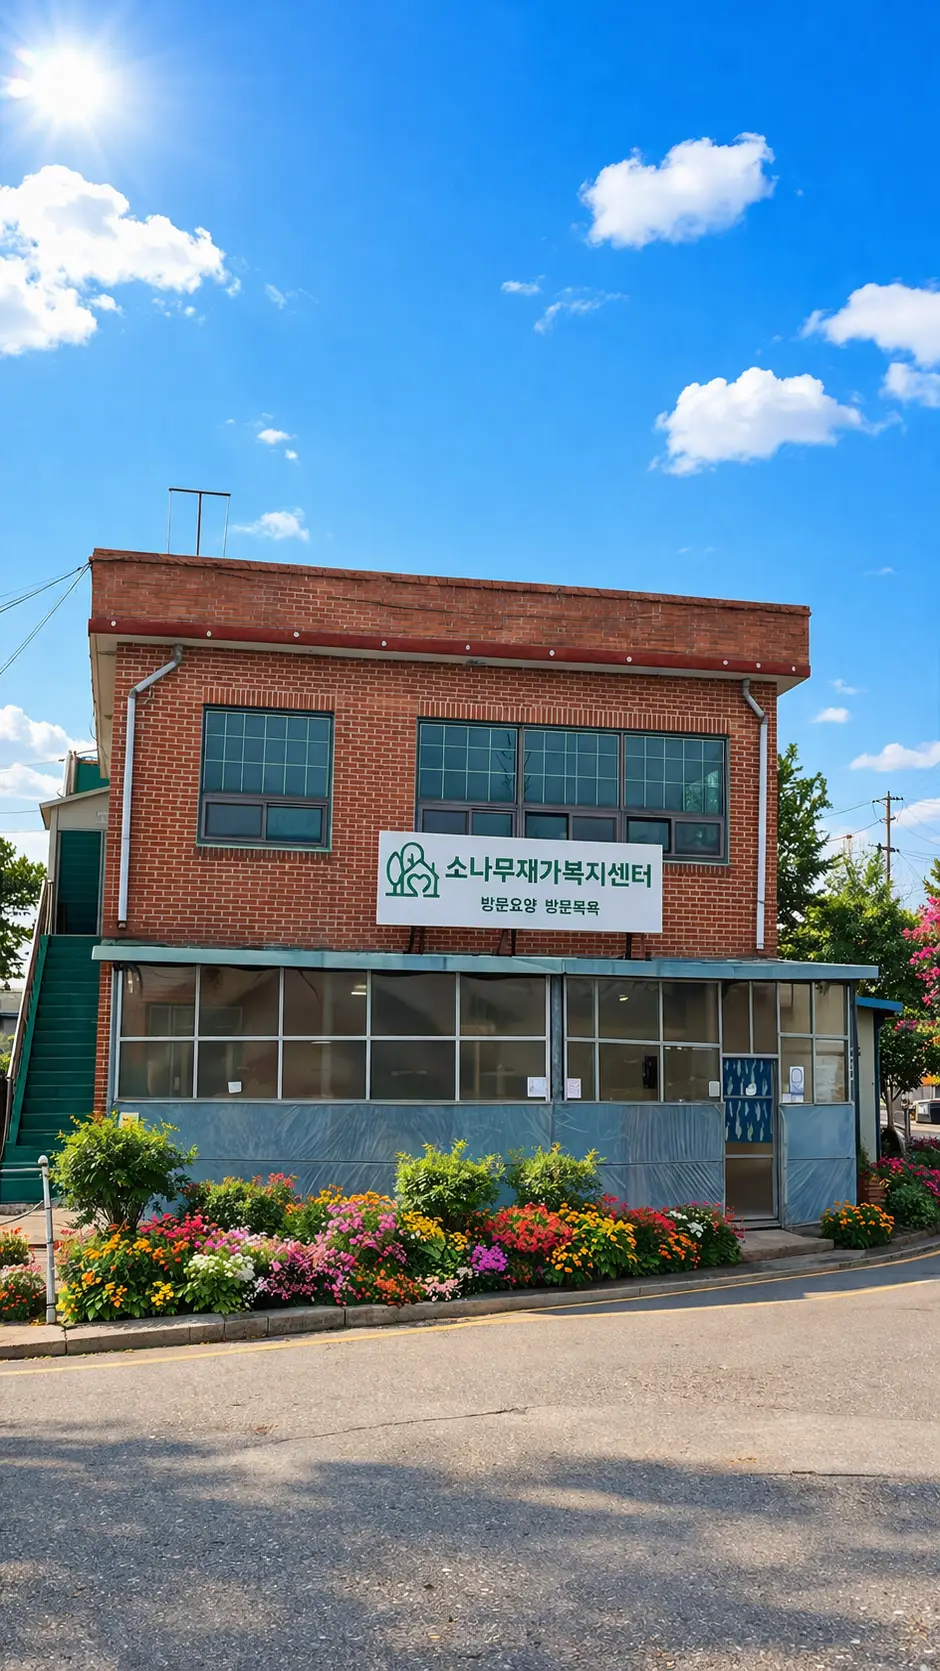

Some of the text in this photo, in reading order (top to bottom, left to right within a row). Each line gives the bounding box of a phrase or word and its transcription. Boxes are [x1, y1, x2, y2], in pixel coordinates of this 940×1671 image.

[445, 856, 652, 888] 소나무재가복지센터
[481, 896, 600, 916] 방문요양 방문목욕
